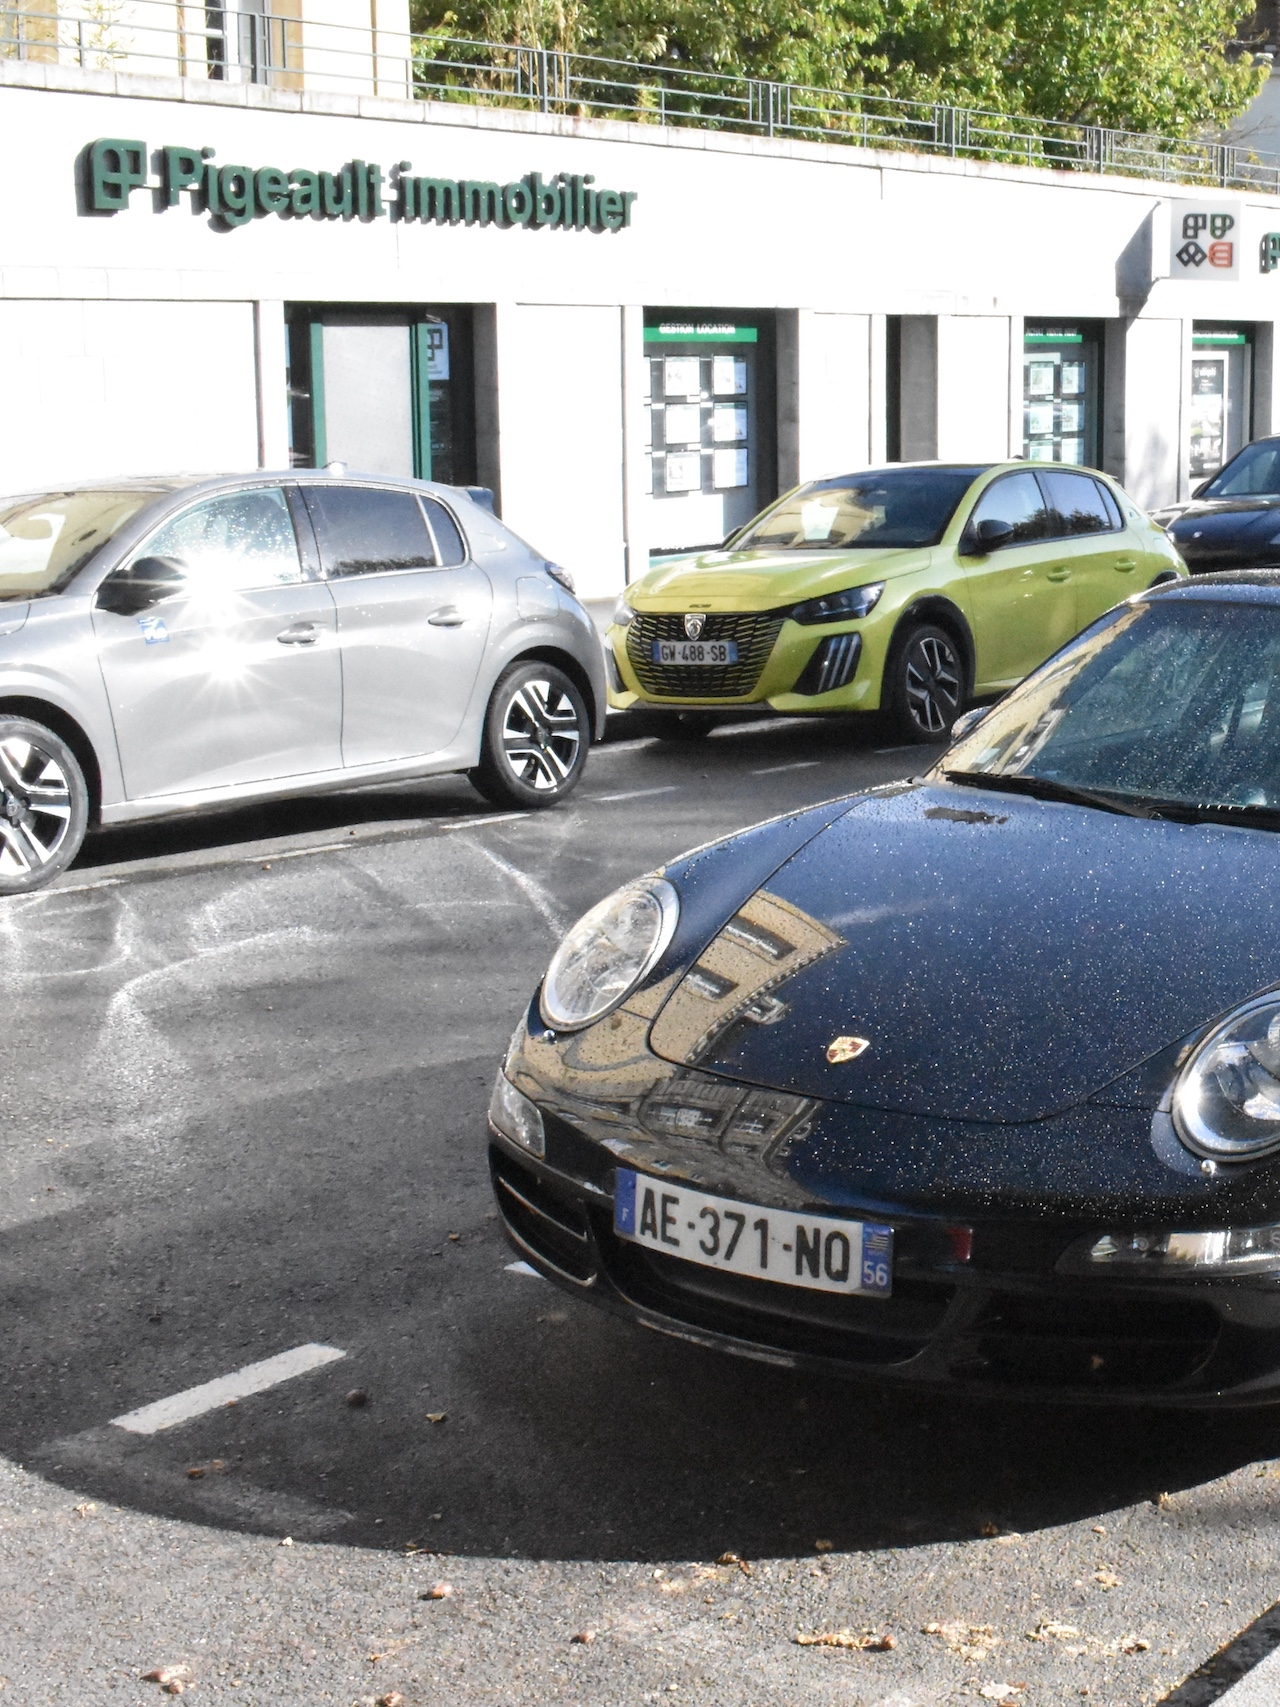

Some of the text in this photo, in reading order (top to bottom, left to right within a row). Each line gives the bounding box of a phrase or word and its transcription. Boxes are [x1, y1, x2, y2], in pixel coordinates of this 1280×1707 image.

[162, 145, 637, 232] Pigeault immobilier
[863, 1260, 888, 1286] 56
